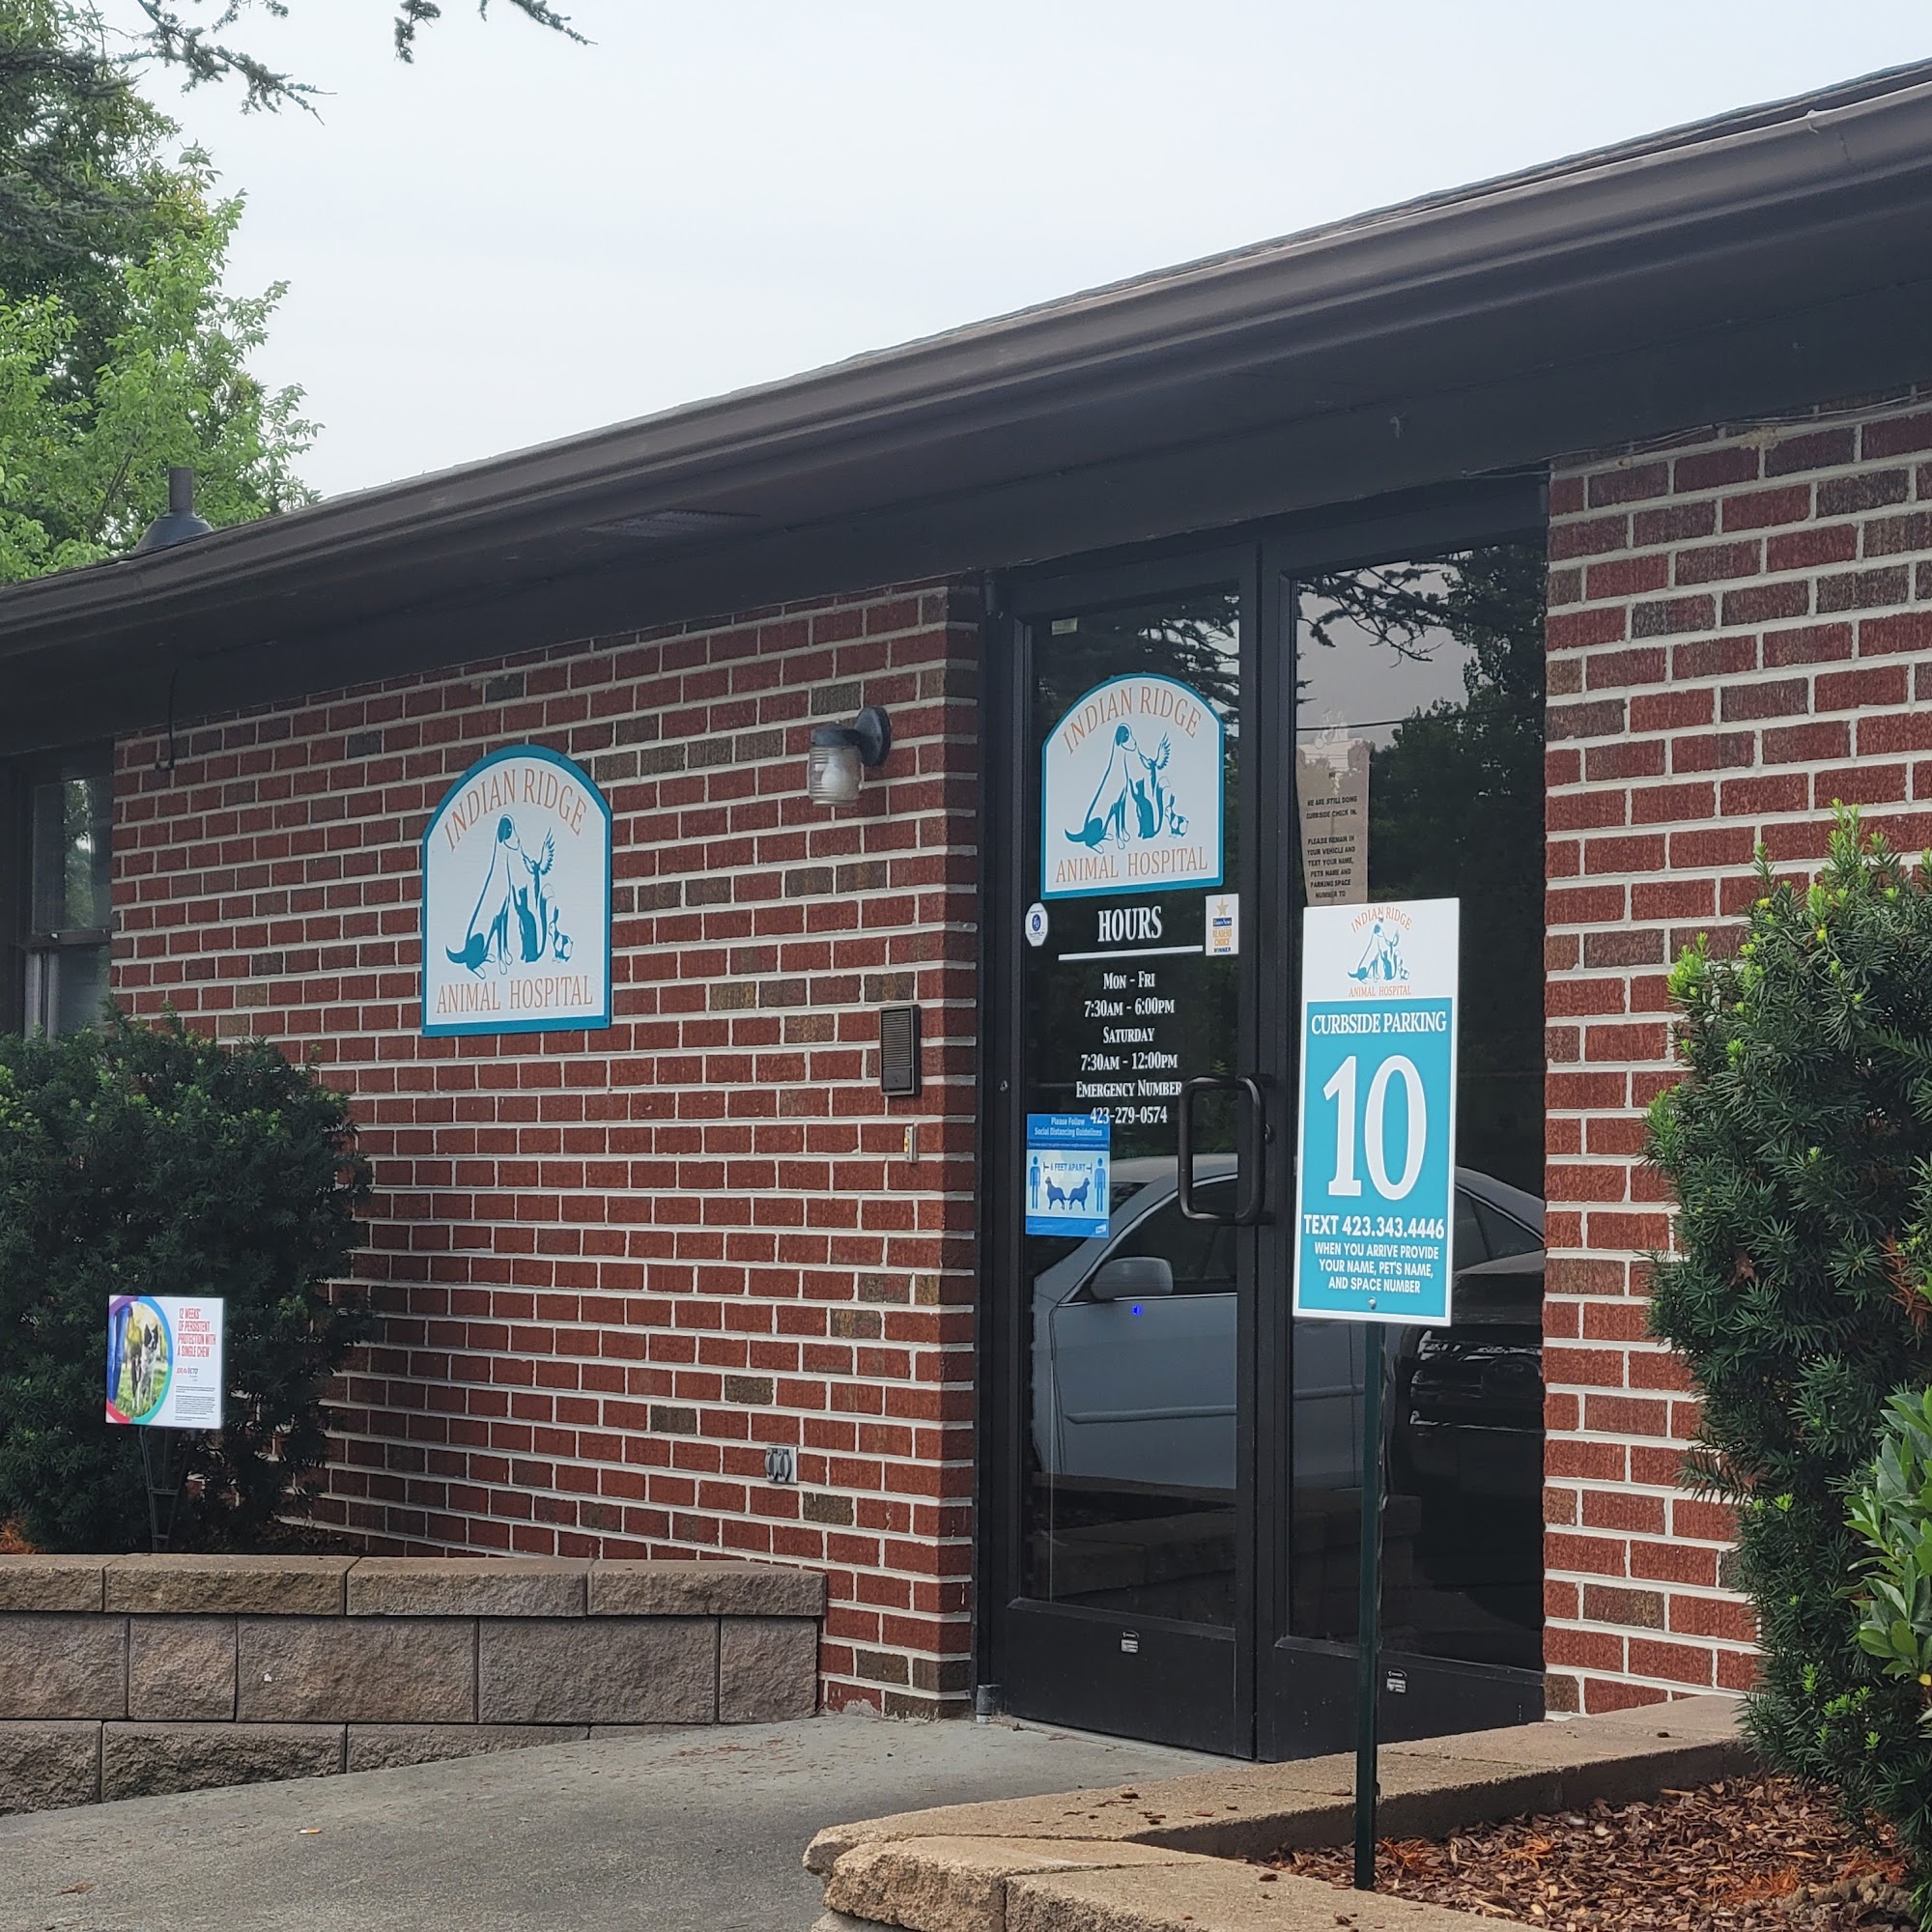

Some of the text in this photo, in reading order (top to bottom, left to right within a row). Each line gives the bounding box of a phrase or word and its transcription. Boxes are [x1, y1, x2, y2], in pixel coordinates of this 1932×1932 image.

[1063, 686, 1202, 755] INDIAN RIDGE
[443, 767, 587, 852] INDIAN RIDGE
[1306, 810, 1330, 819] CURBSIDE
[1322, 846, 1344, 855] VEHICLE
[1055, 846, 1208, 883] ANIMAL HOSPITAL
[1310, 880, 1334, 889] PARKING
[1097, 905, 1162, 942] HOURS
[1350, 906, 1413, 933] INDIAN RIDGE
[436, 975, 593, 1013] ANIMAL HOSPITAL
[1349, 985, 1411, 998] ANIMAL HOSPITAL
[1084, 999, 1123, 1018] 7:30AM
[1134, 997, 1176, 1015] 6:00PM
[1311, 1010, 1447, 1035] CURBSIDE PARKING
[1080, 1053, 1121, 1071] 7:30AM
[1131, 1051, 1179, 1070] 12:00PM
[1051, 1117, 1085, 1125] Please Follow
[1090, 1106, 1168, 1124] 423-279-0574
[1034, 1127, 1103, 1137] Social Distancing Guidelines
[1322, 1054, 1428, 1201] 10
[1068, 1163, 1086, 1172] APART
[1303, 1213, 1445, 1239] TEXT 423.343.4446
[1314, 1241, 1439, 1260] WHEN YOU ARRIVE PROVIDE
[1319, 1259, 1434, 1279] YOUR NAME, PET'S NAME,
[1328, 1276, 1421, 1293] AND SPACE NUMBER
[177, 1332, 205, 1345] PROTECTION
[178, 1346, 211, 1357] A SINGLE CHEW
